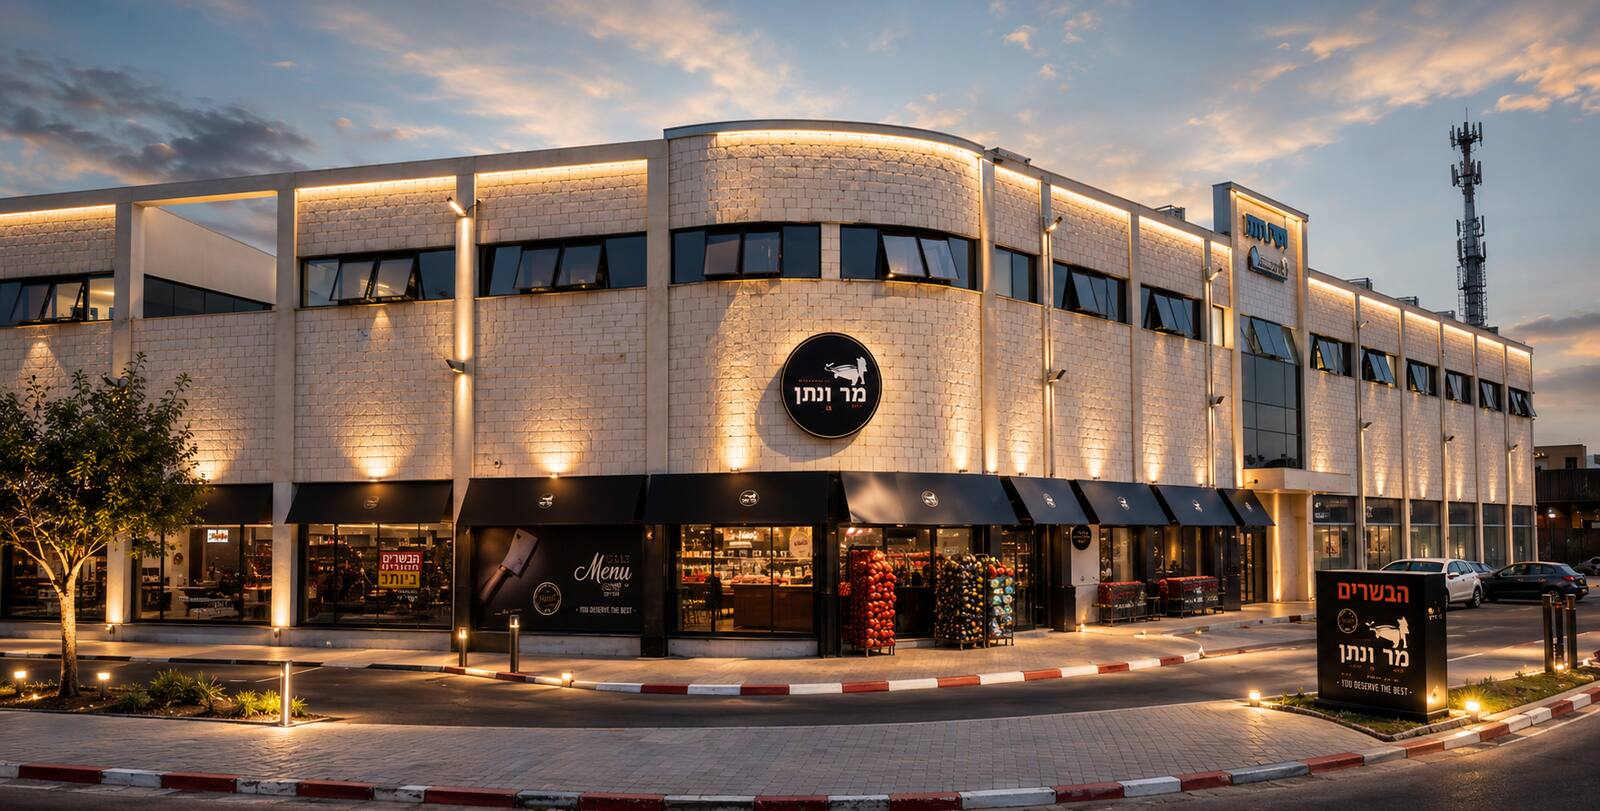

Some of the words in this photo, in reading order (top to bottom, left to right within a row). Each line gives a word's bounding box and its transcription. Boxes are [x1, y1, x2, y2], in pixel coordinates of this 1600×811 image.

[794, 386, 832, 405] ונתן
[840, 386, 866, 402] מר
[382, 554, 420, 564] הבשרים
[574, 552, 632, 584] Menu
[1337, 582, 1409, 603] הבשרים
[1338, 643, 1375, 663] ונתן
[1382, 648, 1409, 667] מר
[1353, 680, 1379, 692] DESERVE
[1380, 684, 1392, 694] THE
[1392, 686, 1408, 696] BEST
